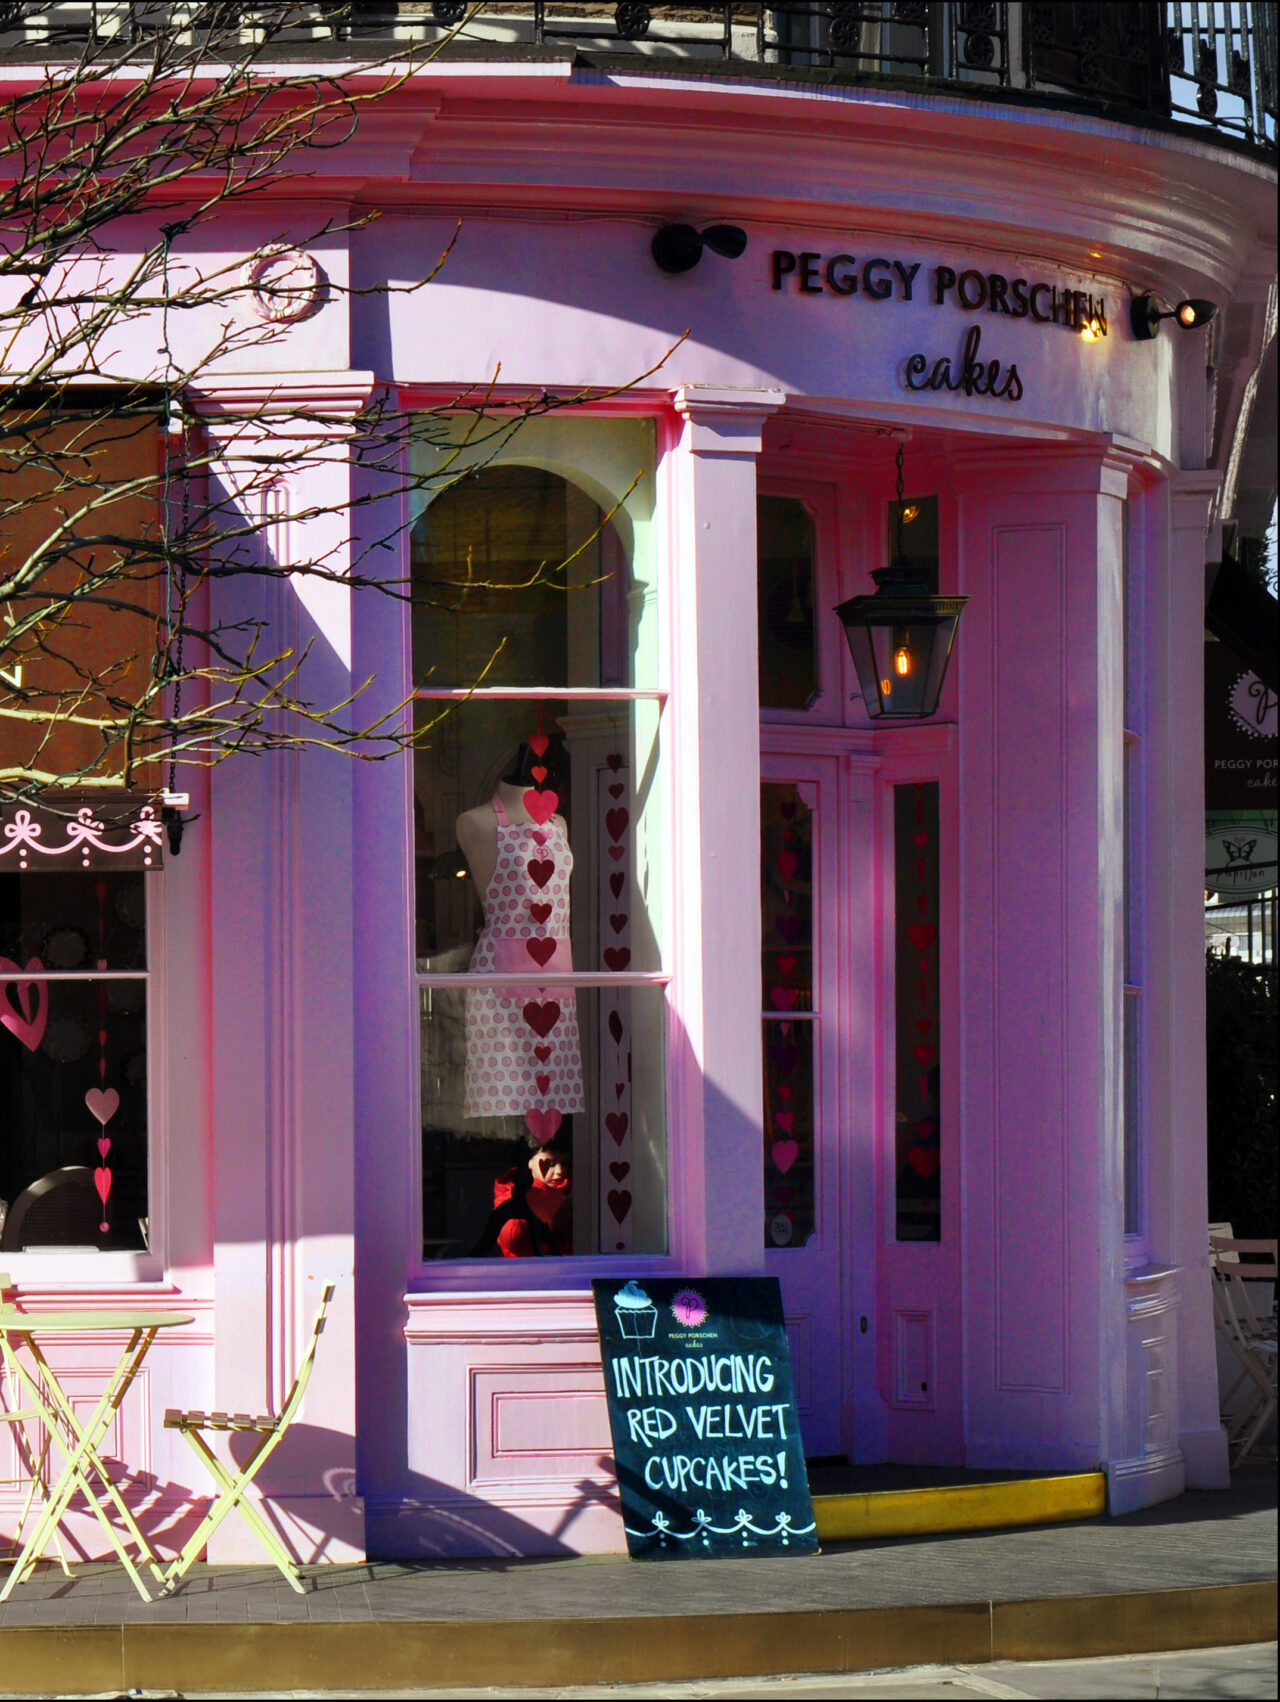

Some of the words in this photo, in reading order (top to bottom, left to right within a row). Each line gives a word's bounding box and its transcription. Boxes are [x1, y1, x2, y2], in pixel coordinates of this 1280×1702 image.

[772, 249, 922, 300] PEGGY
[935, 265, 1108, 337] PORSCHEN
[905, 324, 1023, 401] cakes
[1214, 759, 1254, 770] PEGGY
[612, 1354, 774, 1397] INTRODUCING
[627, 1406, 677, 1448] RED
[686, 1403, 790, 1440] VELVET
[644, 1451, 788, 1492] CUPCAKES!
